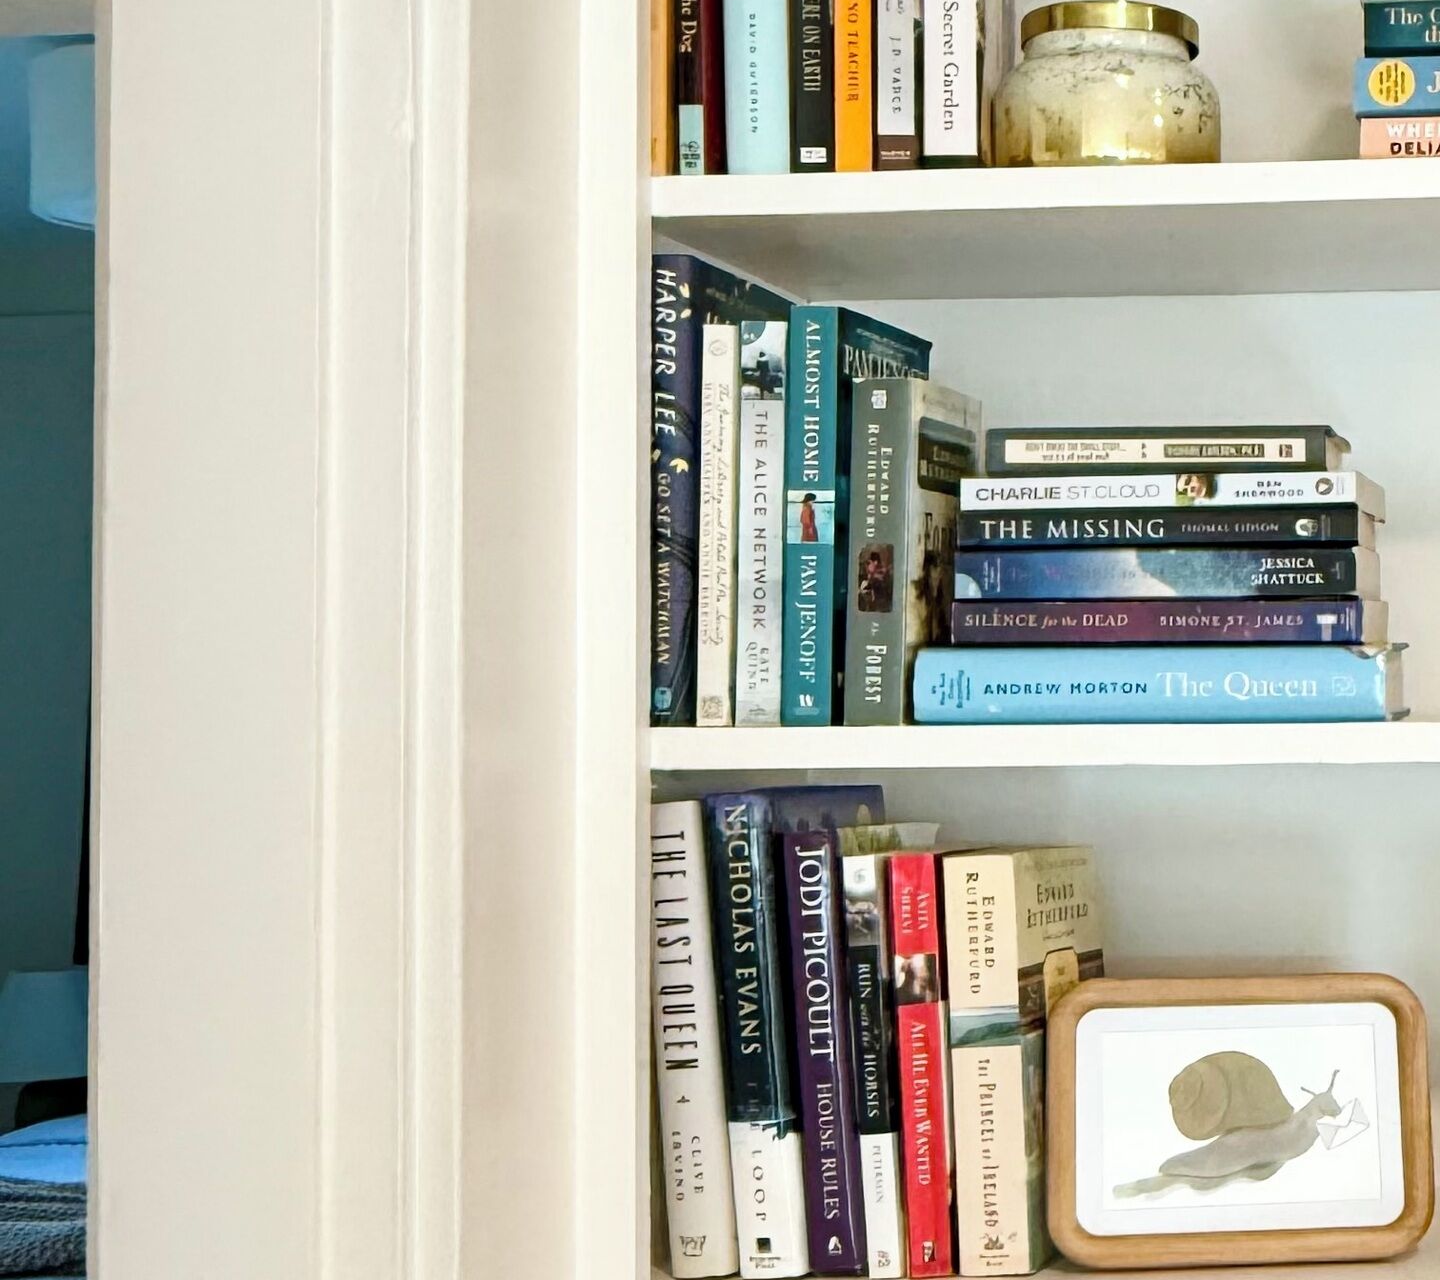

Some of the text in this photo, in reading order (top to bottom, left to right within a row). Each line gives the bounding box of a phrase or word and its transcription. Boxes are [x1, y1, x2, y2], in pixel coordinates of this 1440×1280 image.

[803, 26, 820, 44] ON
[943, 2, 959, 56] Secret
[1385, 7, 1423, 25] The
[803, 49, 821, 92] EARTH
[942, 62, 960, 131] Garden
[655, 270, 677, 436] HARPER LEE
[803, 320, 820, 482] ALMOST HOME
[752, 411, 768, 630] THE ALICE NETWORK
[981, 519, 1165, 539] THE MISSING
[1251, 573, 1324, 586] SHATTUCK
[1260, 557, 1315, 570] JESSICA
[796, 555, 818, 683] PAM JENOFF
[965, 613, 1128, 630] SILENCE for the DEAD
[983, 682, 1061, 695] ANDREW
[1070, 681, 1148, 694] MORTON
[1156, 671, 1212, 698] The
[1224, 671, 1318, 698] Queen
[652, 831, 699, 1071] THE LAST QUEEN
[725, 805, 761, 1056] NICHOLAS EVANS
[796, 846, 834, 1061] JODI PICOULT
[692, 1136, 703, 1194] CLIVE
[817, 1084, 839, 1219] HOUSE RULES
